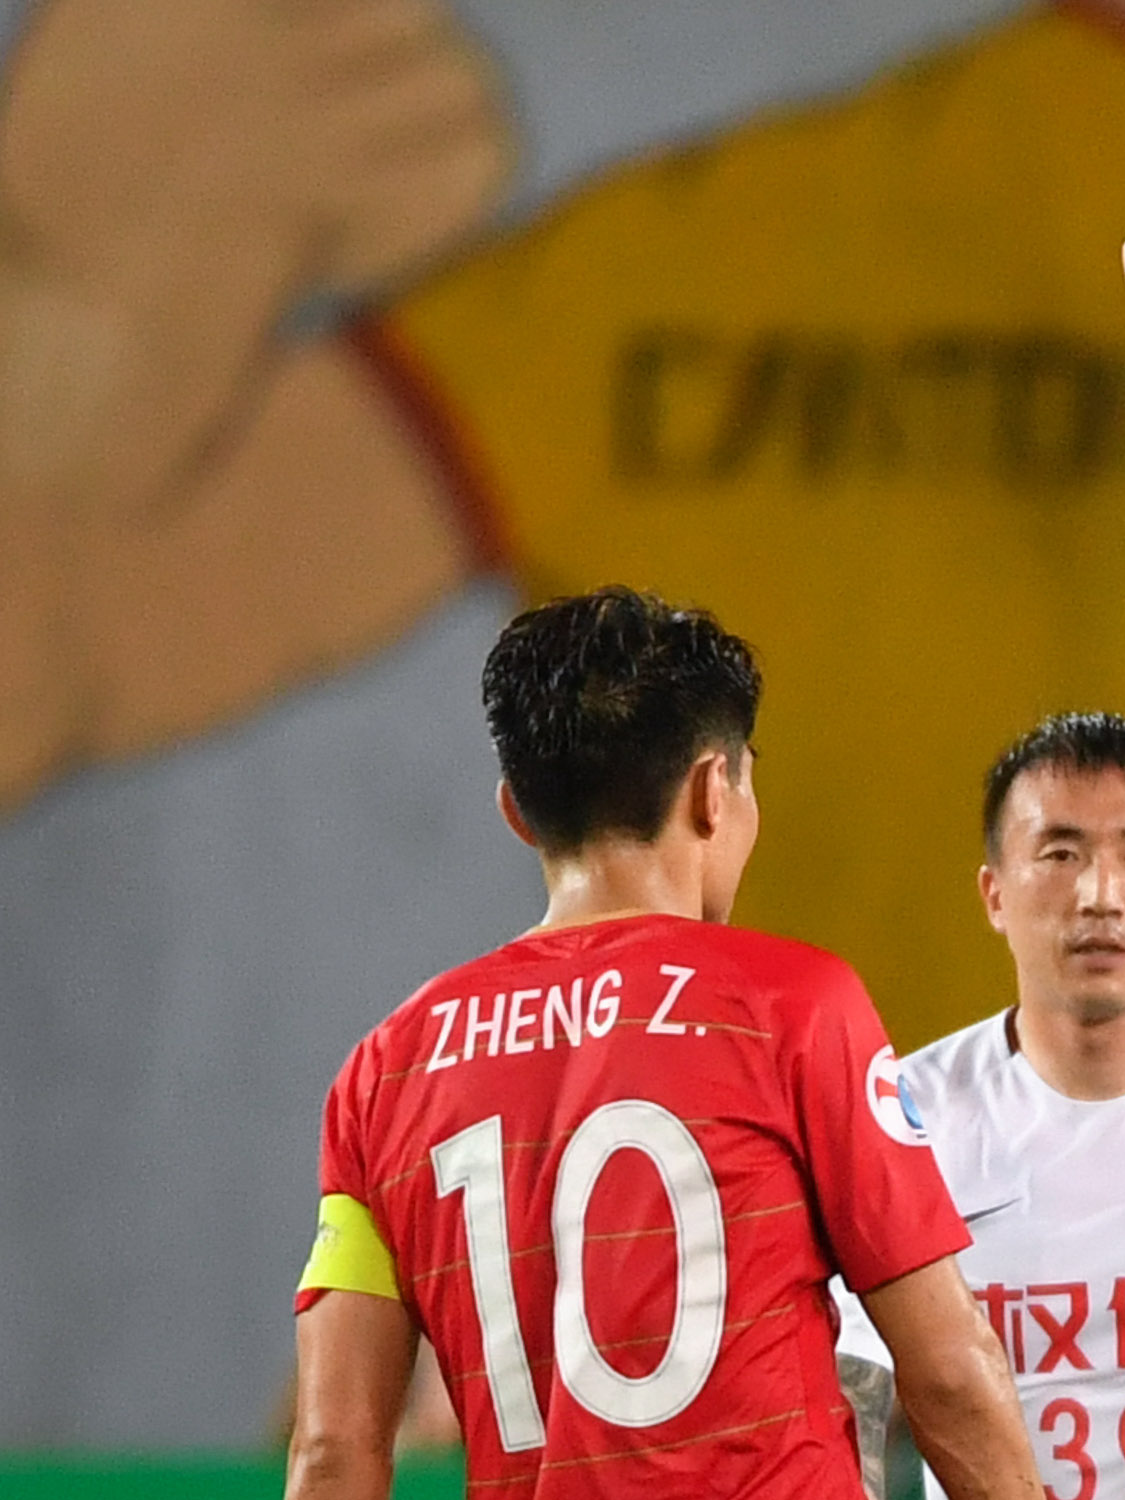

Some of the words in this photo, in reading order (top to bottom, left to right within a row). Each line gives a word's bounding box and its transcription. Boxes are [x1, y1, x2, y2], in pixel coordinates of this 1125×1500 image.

[425, 970, 622, 1073] ZHENG
[645, 964, 707, 1036] Z.
[430, 1099, 727, 1453] 10
